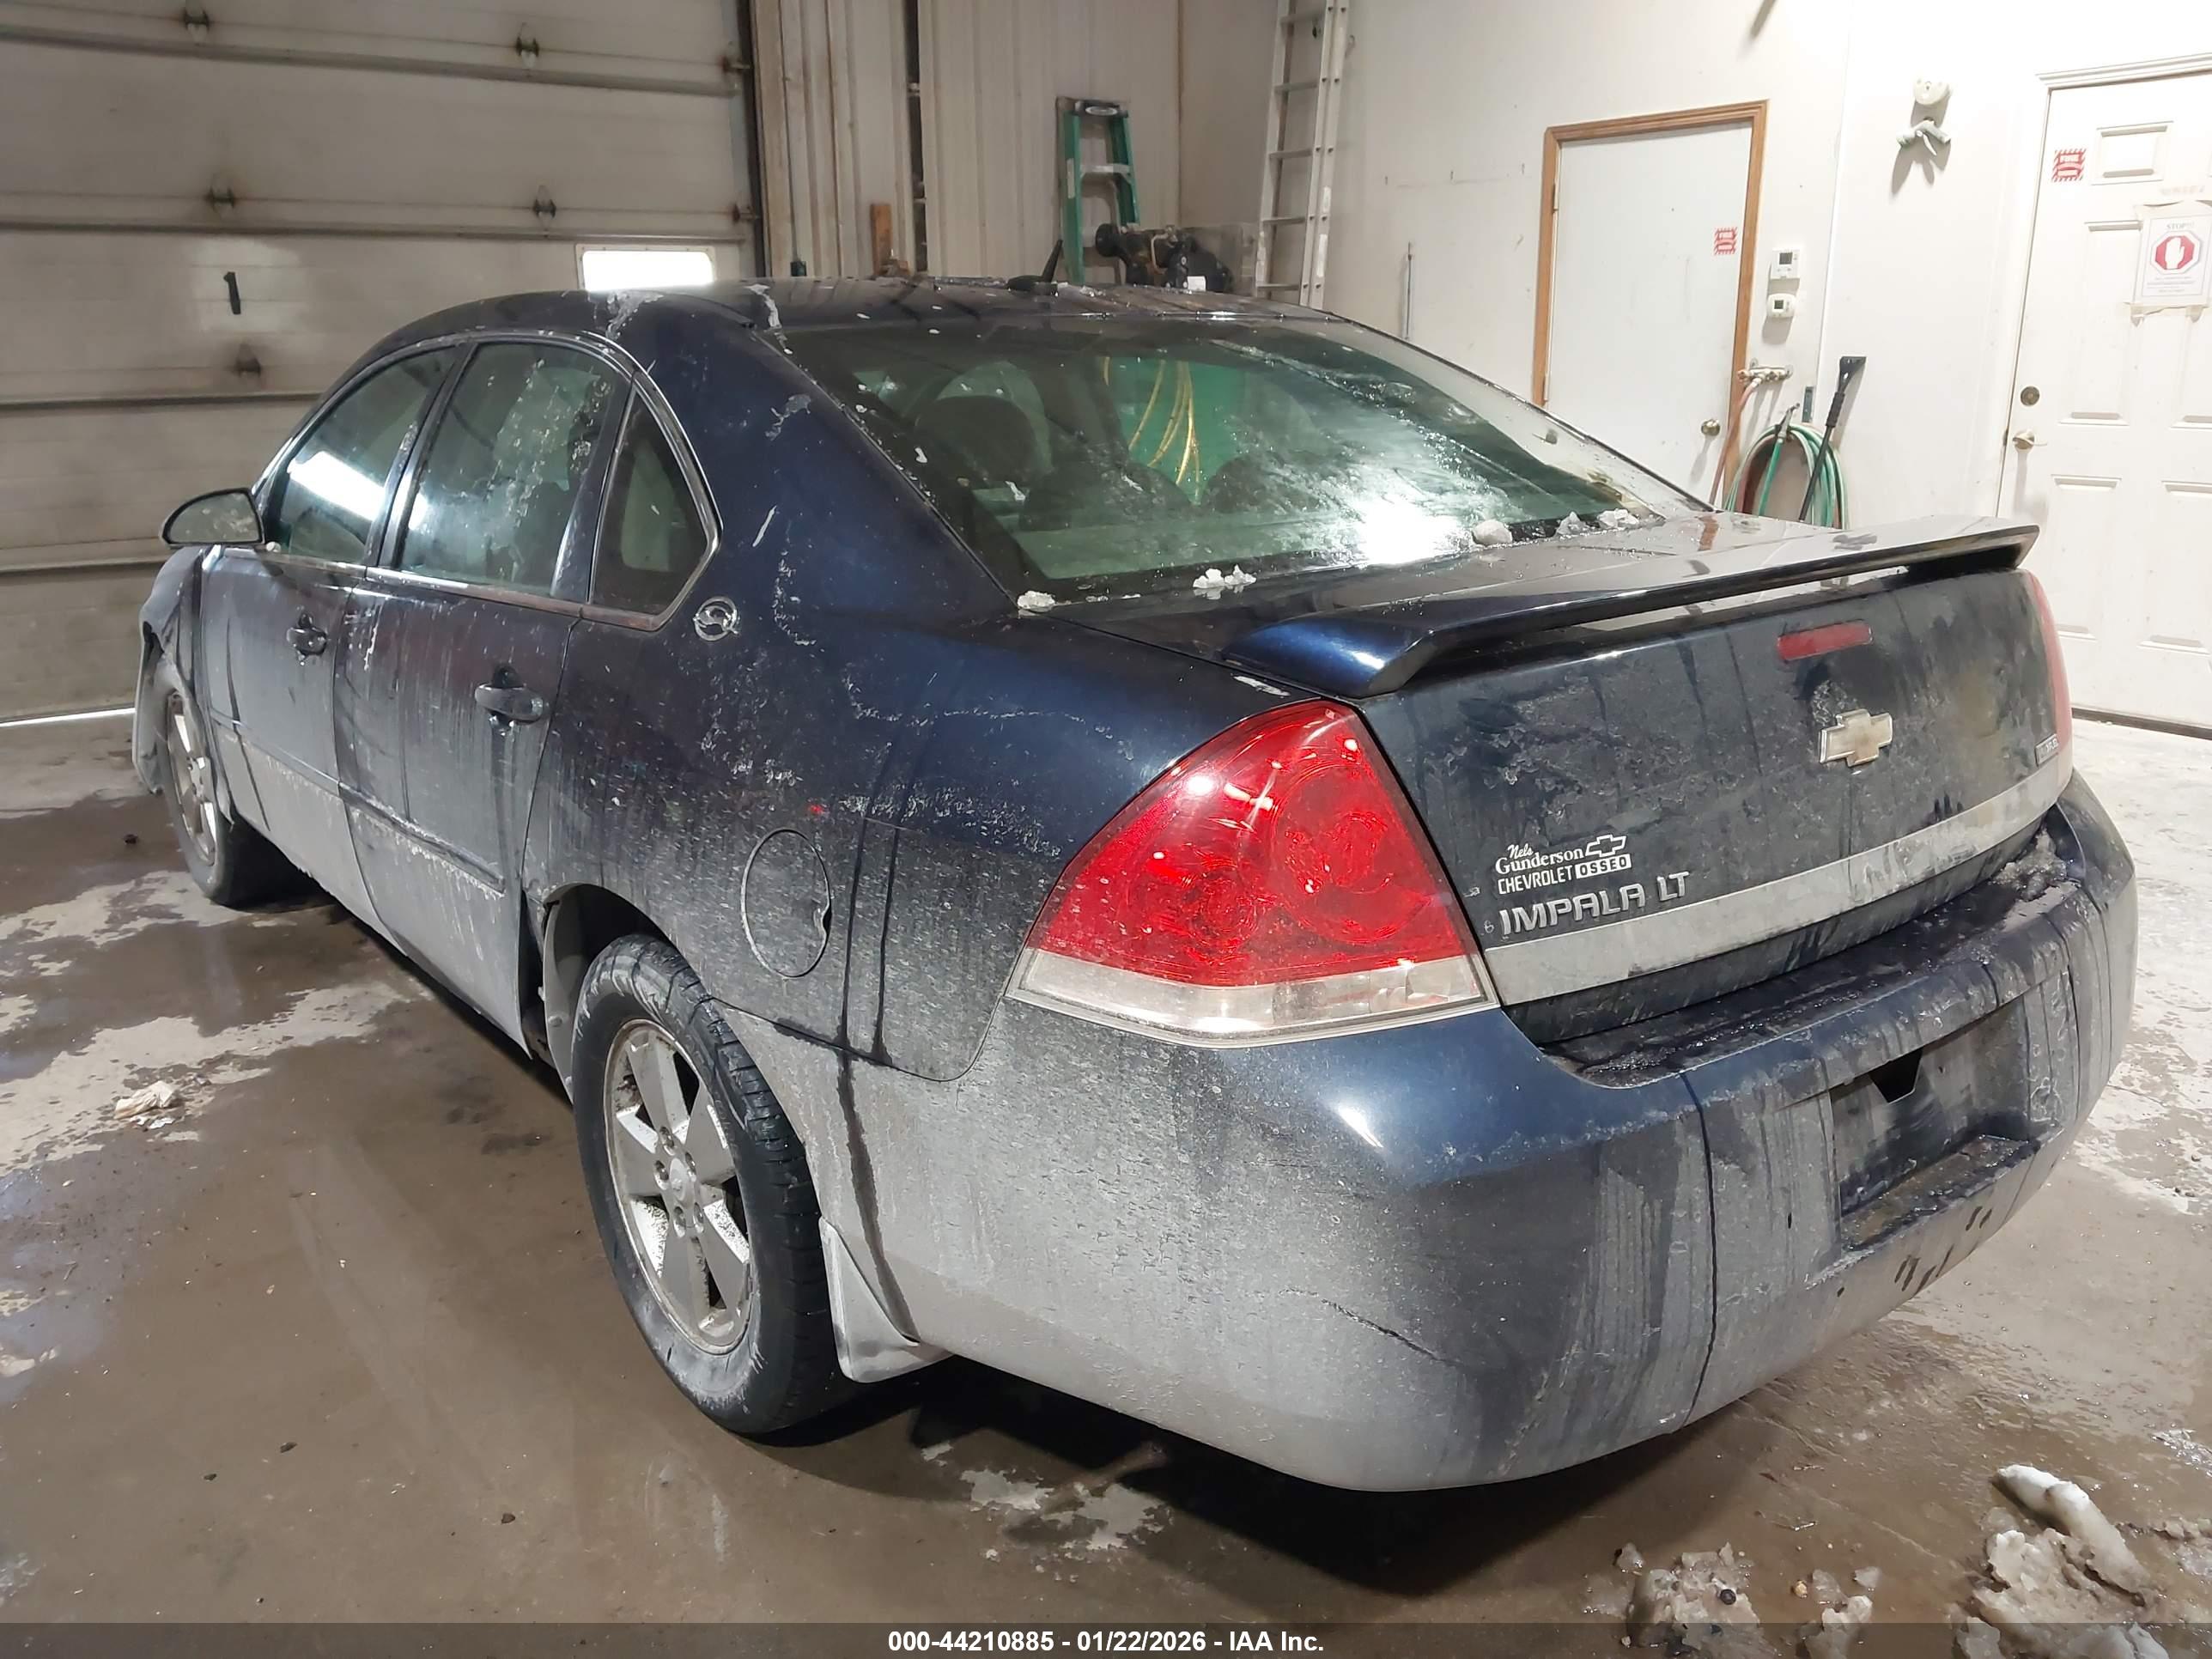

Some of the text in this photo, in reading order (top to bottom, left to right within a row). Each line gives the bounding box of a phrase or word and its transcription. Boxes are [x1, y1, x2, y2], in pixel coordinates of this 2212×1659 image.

[223, 270, 241, 315] 1
[1495, 848, 1584, 875] Gunderson
[1507, 842, 1534, 859] Nels
[1498, 855, 1629, 895] CHEVROLET OSSEO
[1499, 871, 1690, 936] IMPALA LT
